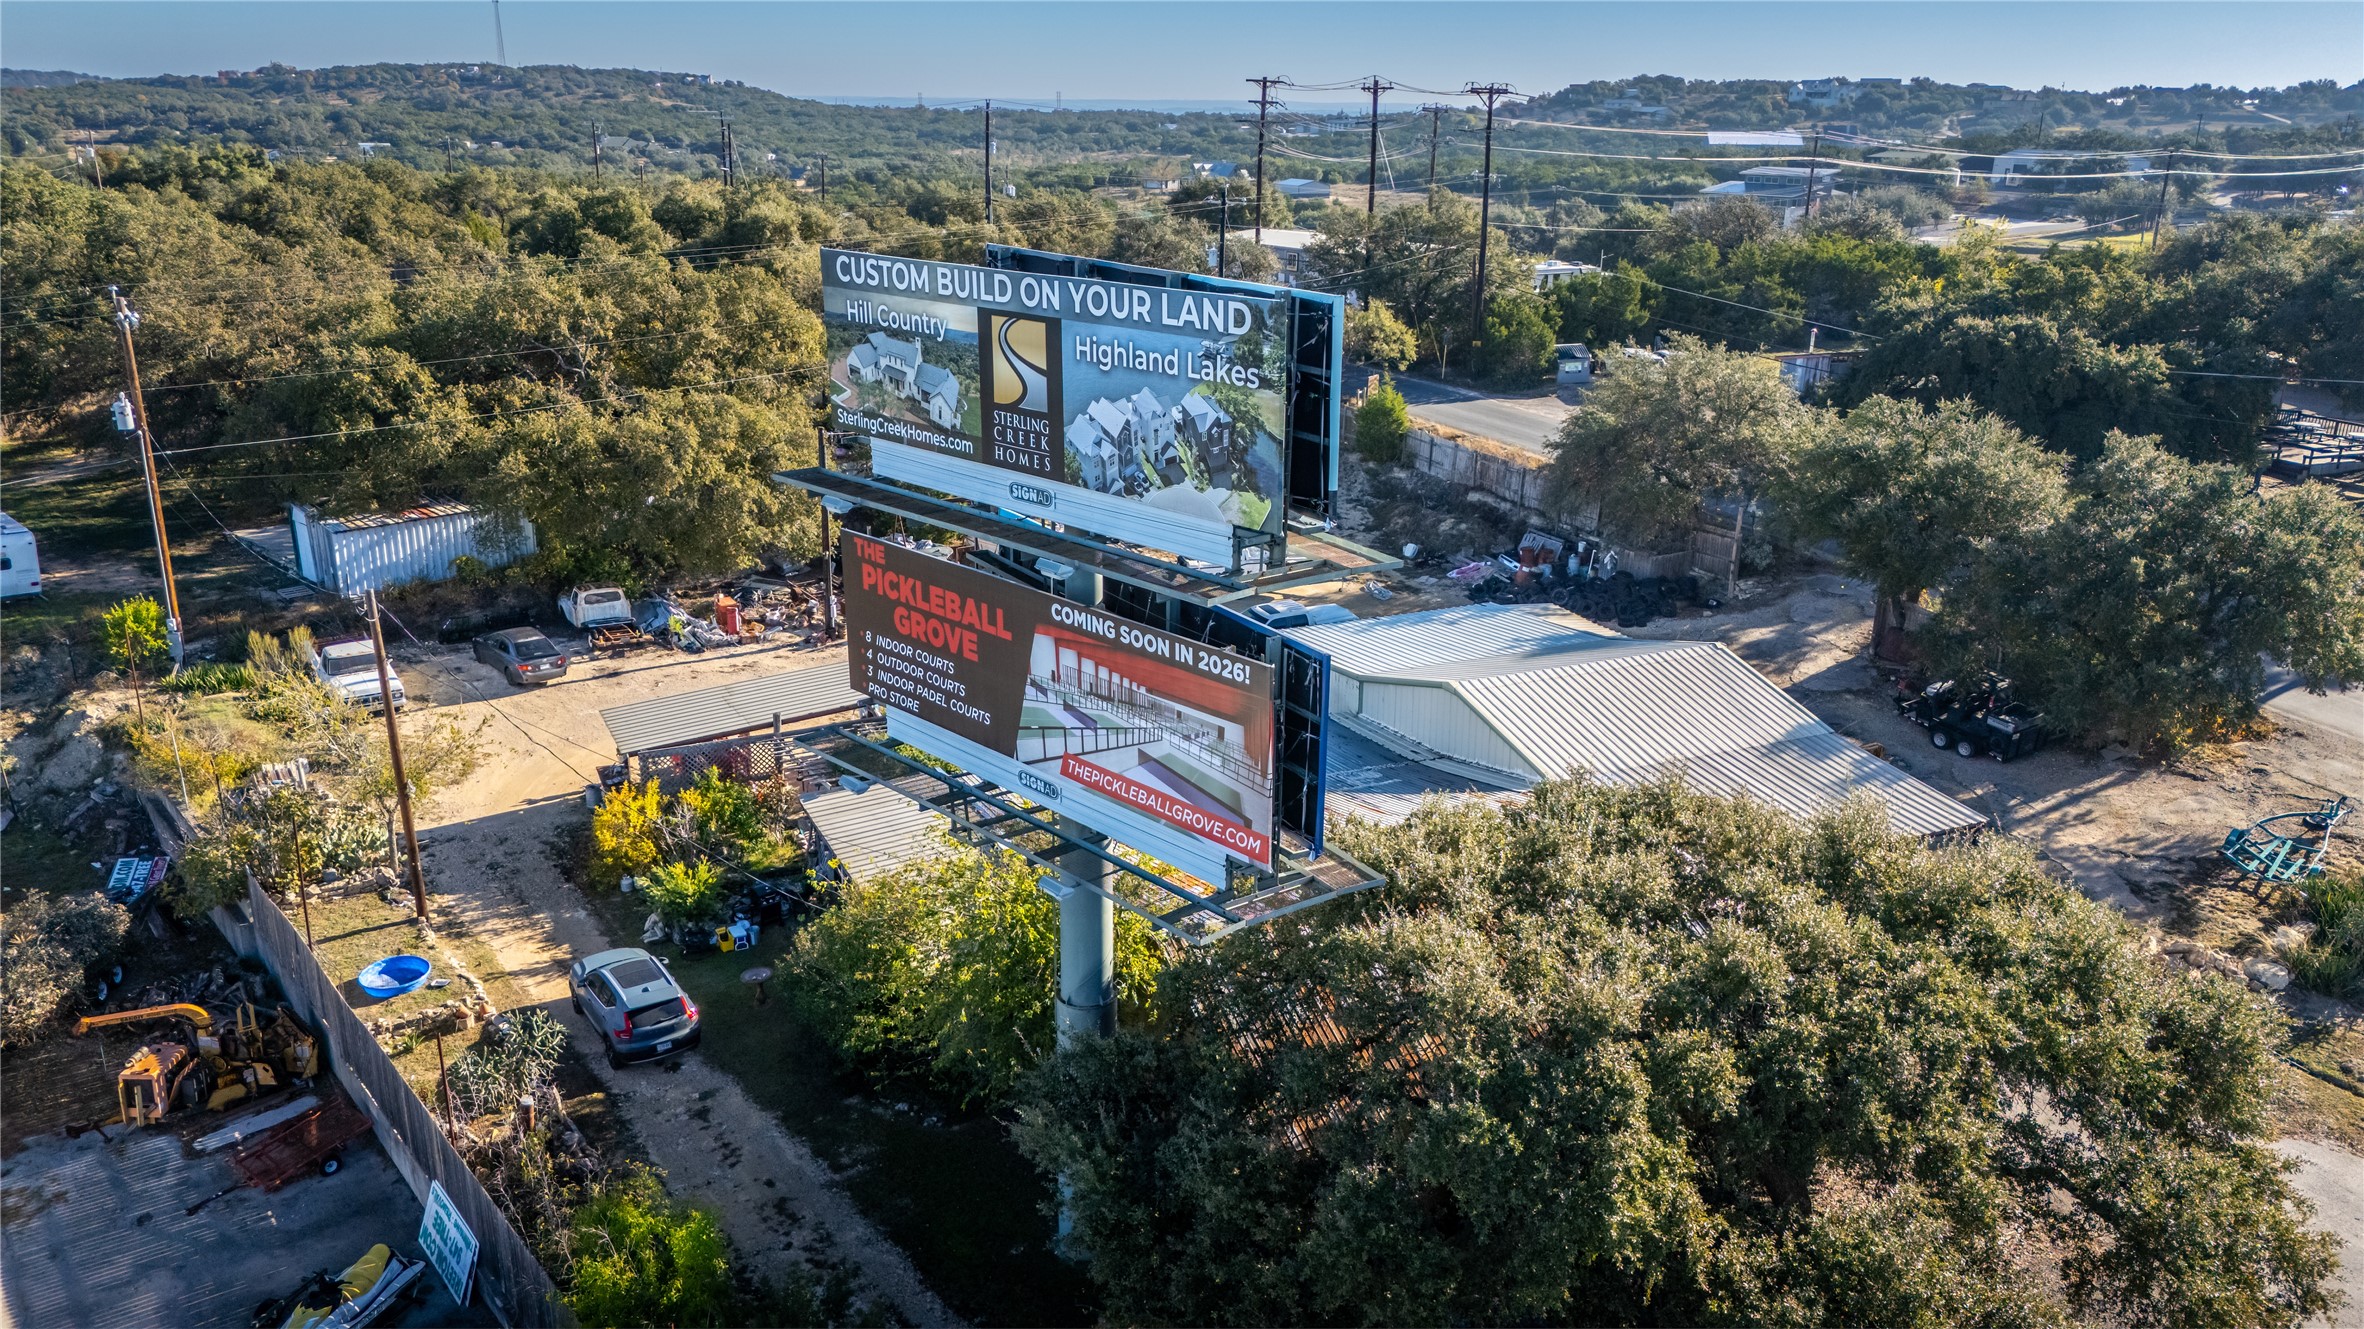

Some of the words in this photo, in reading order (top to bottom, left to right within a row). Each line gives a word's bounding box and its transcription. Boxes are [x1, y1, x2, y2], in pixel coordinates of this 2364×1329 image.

[836, 255, 930, 293] CUSTOM
[937, 267, 1012, 303] BUILD
[1019, 277, 1060, 311] ON
[1068, 281, 1151, 323] YOUR
[1162, 293, 1252, 335] LAND
[846, 300, 873, 324] Hill
[877, 304, 947, 342] Country
[1075, 335, 1179, 376] Highland
[1187, 351, 1260, 389] Lakes
[837, 409, 974, 454] SterlingCreekHomes.com
[993, 410, 1050, 434] STERLING
[994, 426, 1050, 450] CREEK
[995, 446, 1051, 472] HOMES
[853, 537, 886, 565] THE
[862, 562, 1013, 641] PICKLEBALL
[865, 630, 872, 642] 8
[876, 634, 913, 658] INDOOR
[915, 649, 955, 674] COURTS
[893, 606, 979, 662] GROVE
[1051, 603, 1116, 639] COMING
[1119, 626, 1170, 658] SOON
[1175, 642, 1194, 666] IN
[1198, 651, 1251, 685] 2026!
[866, 649, 873, 659] 4
[877, 652, 924, 680] OUTDOOR
[926, 671, 966, 697] COURTS
[867, 665, 873, 676] 3
[877, 669, 915, 693] INDOOR
[916, 685, 948, 708] PADEL
[950, 699, 991, 725] COURTS
[868, 682, 888, 699] PRO
[889, 690, 920, 712] STORE
[1067, 758, 1261, 853] THEPICKLEBALLGROVE.COM
